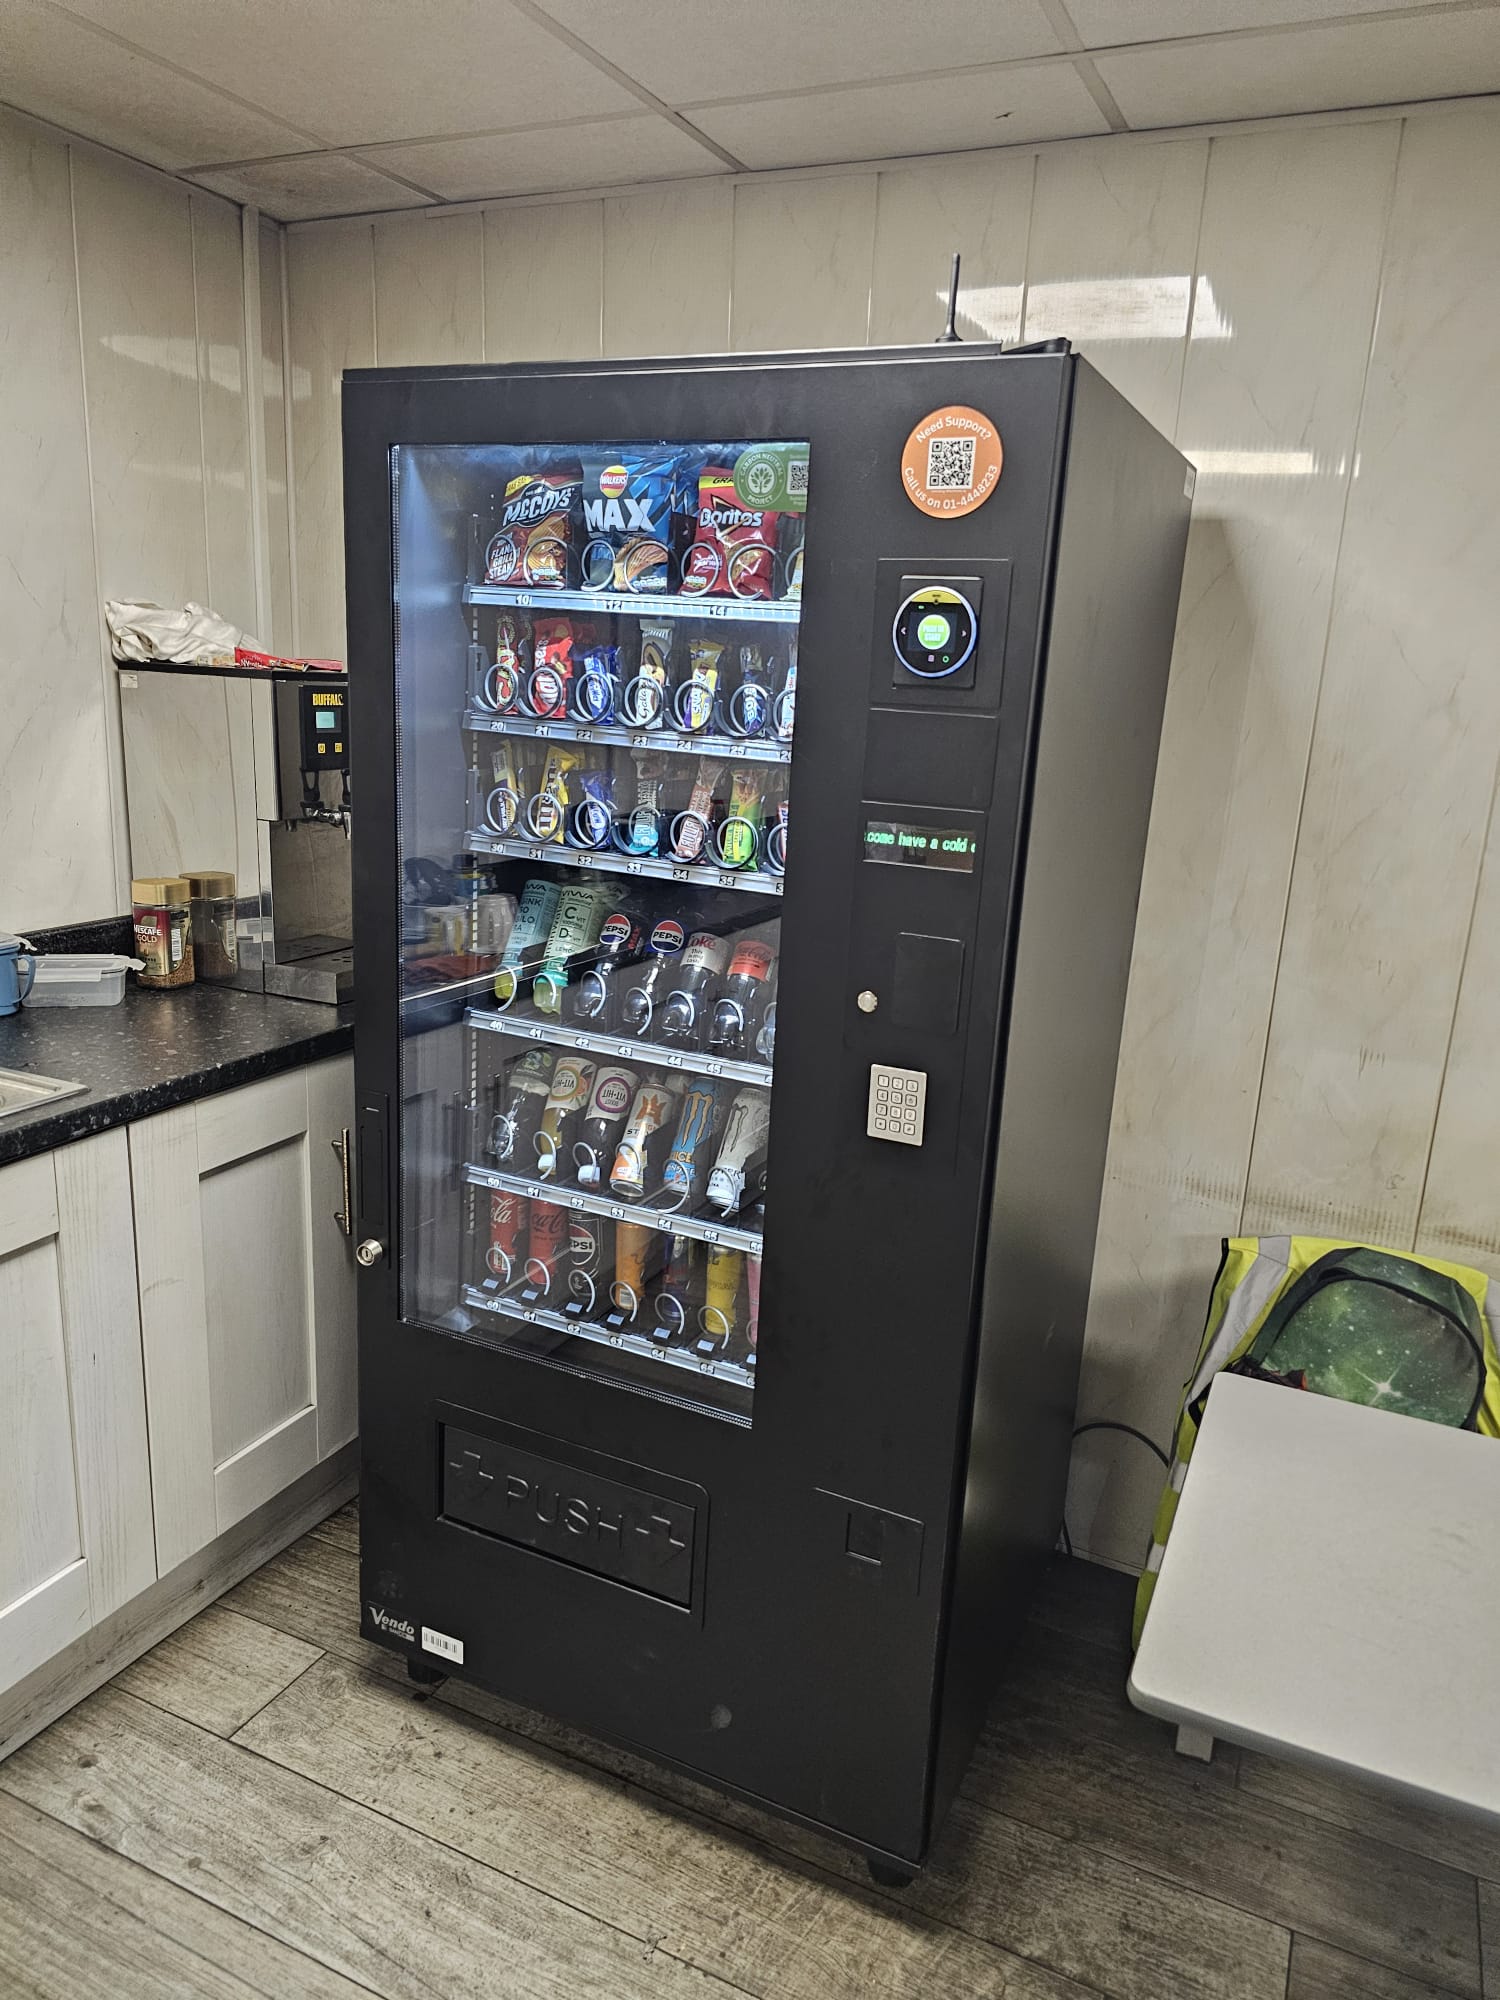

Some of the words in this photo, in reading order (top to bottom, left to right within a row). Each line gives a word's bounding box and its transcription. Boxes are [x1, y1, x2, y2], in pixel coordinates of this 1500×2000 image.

[916, 418, 944, 443] Need
[945, 416, 992, 440] Support?
[905, 467, 919, 490] Call
[915, 490, 926, 501] us
[927, 498, 940, 508] on
[943, 465, 998, 510] 01-4448233
[583, 499, 656, 532] MAX
[700, 508, 764, 528] Doritos
[491, 721, 503, 730] 20
[536, 726, 549, 736] 21
[578, 730, 591, 740] 22
[634, 737, 647, 745] 23
[678, 741, 692, 750] 24
[730, 746, 745, 755] 25
[864, 831, 895, 845] come
[898, 831, 927, 848] have
[930, 838, 939, 850] a
[942, 837, 968, 853] cold
[491, 844, 503, 853] 30
[530, 850, 542, 859] 31
[578, 856, 592, 865] 32
[673, 870, 688, 879] 34
[719, 877, 734, 886] 35
[603, 924, 627, 936] PEPSI
[652, 931, 682, 944] PEPSI
[688, 935, 716, 950] oke
[576, 1037, 589, 1047] 42
[707, 1064, 721, 1073] 45
[704, 1231, 718, 1240] 55
[571, 1241, 593, 1250] PSI
[506, 1475, 623, 1550] PUSH
[369, 1606, 415, 1635] Vendo
